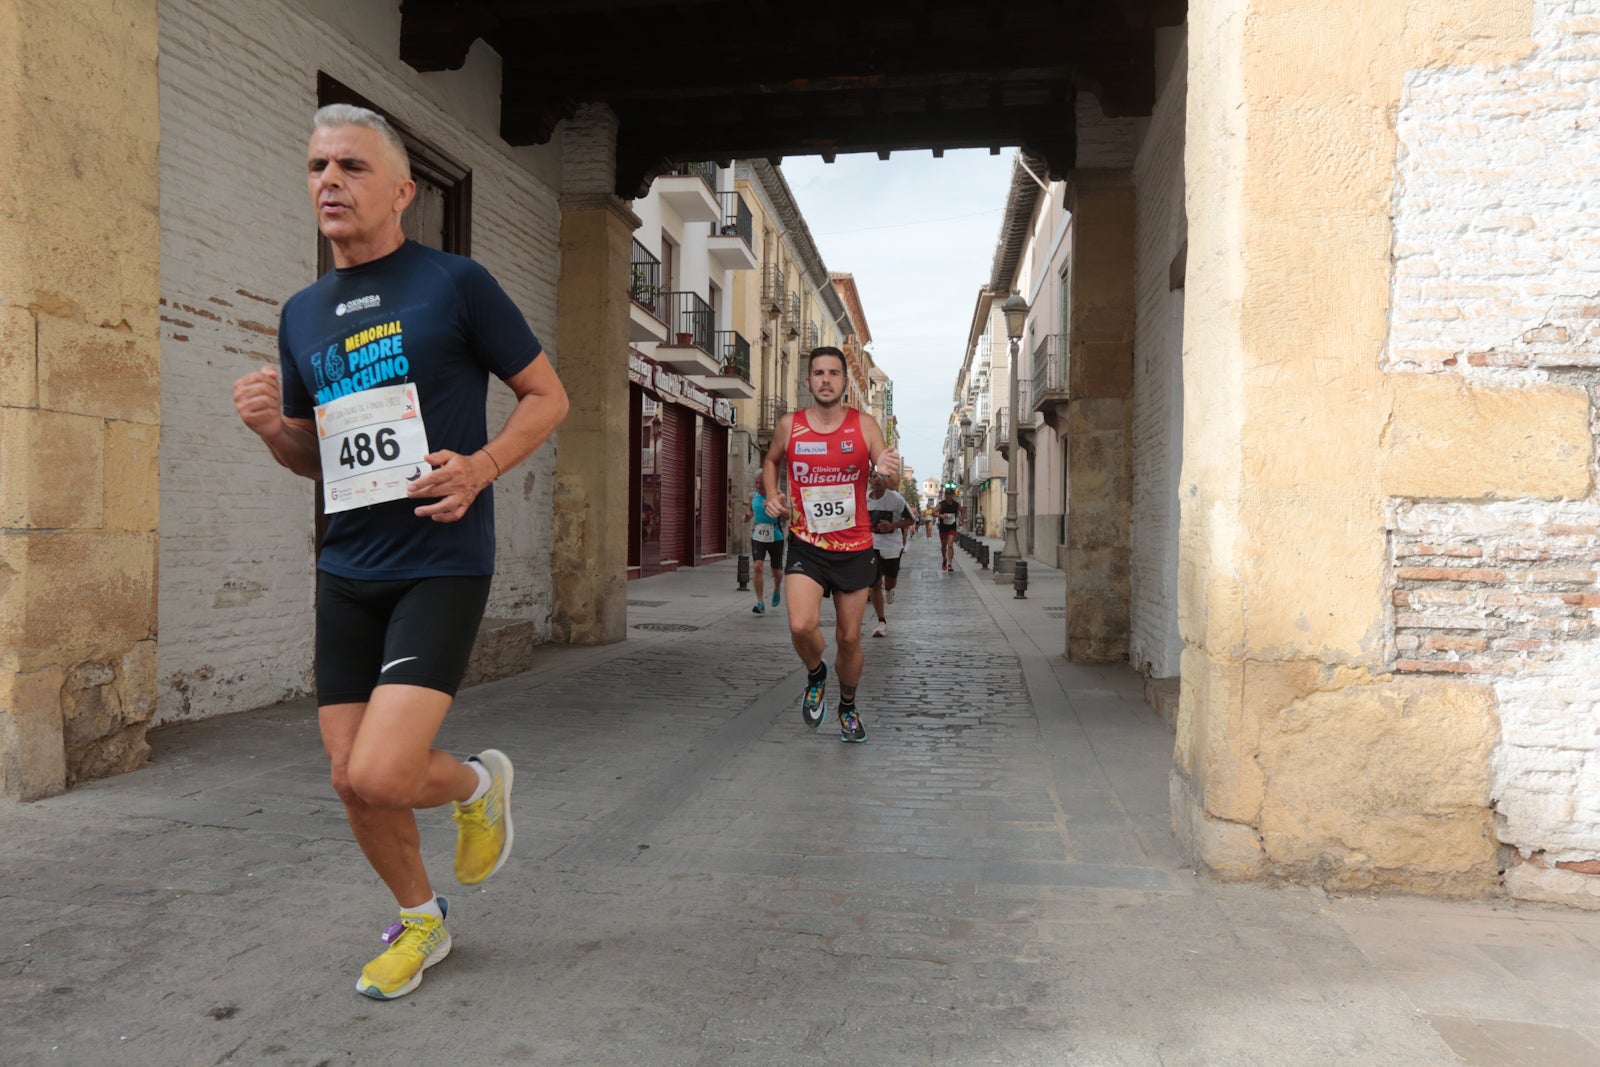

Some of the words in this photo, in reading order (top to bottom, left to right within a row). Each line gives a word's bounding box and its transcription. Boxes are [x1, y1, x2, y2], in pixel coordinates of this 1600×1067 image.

[345, 320, 402, 352] MEMORIAL
[348, 335, 403, 372] PADRE
[311, 343, 345, 388] 16
[316, 355, 409, 405] MARCELINO
[339, 427, 400, 470] 486
[792, 461, 860, 484] Polisalud
[813, 501, 845, 518] 395
